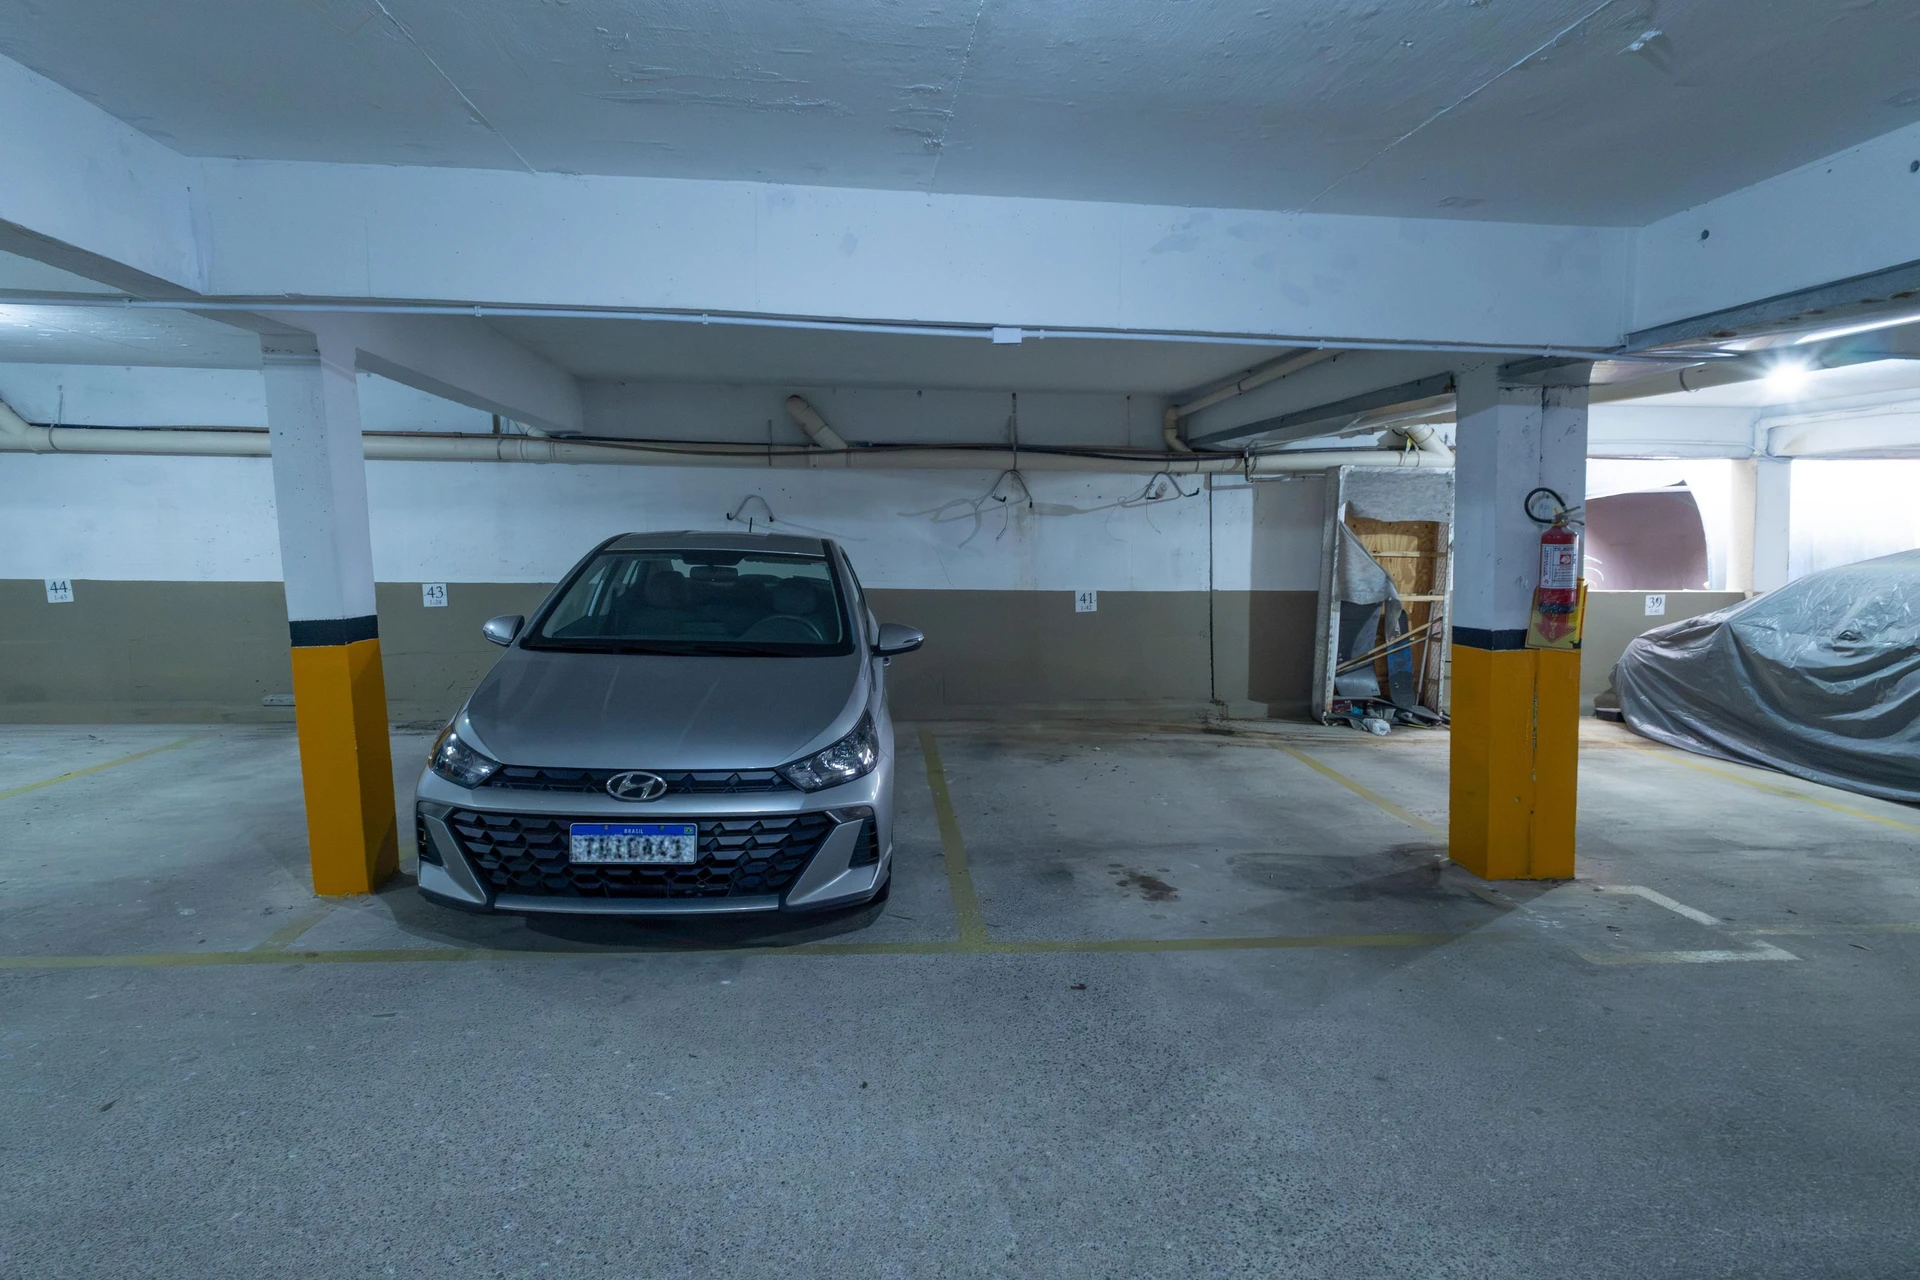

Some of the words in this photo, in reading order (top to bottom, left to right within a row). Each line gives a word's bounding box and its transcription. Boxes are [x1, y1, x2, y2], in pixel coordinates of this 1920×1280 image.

[50, 581, 68, 593] 44
[427, 586, 444, 598] 43
[1079, 592, 1093, 604] 41
[1649, 596, 1663, 608] 39
